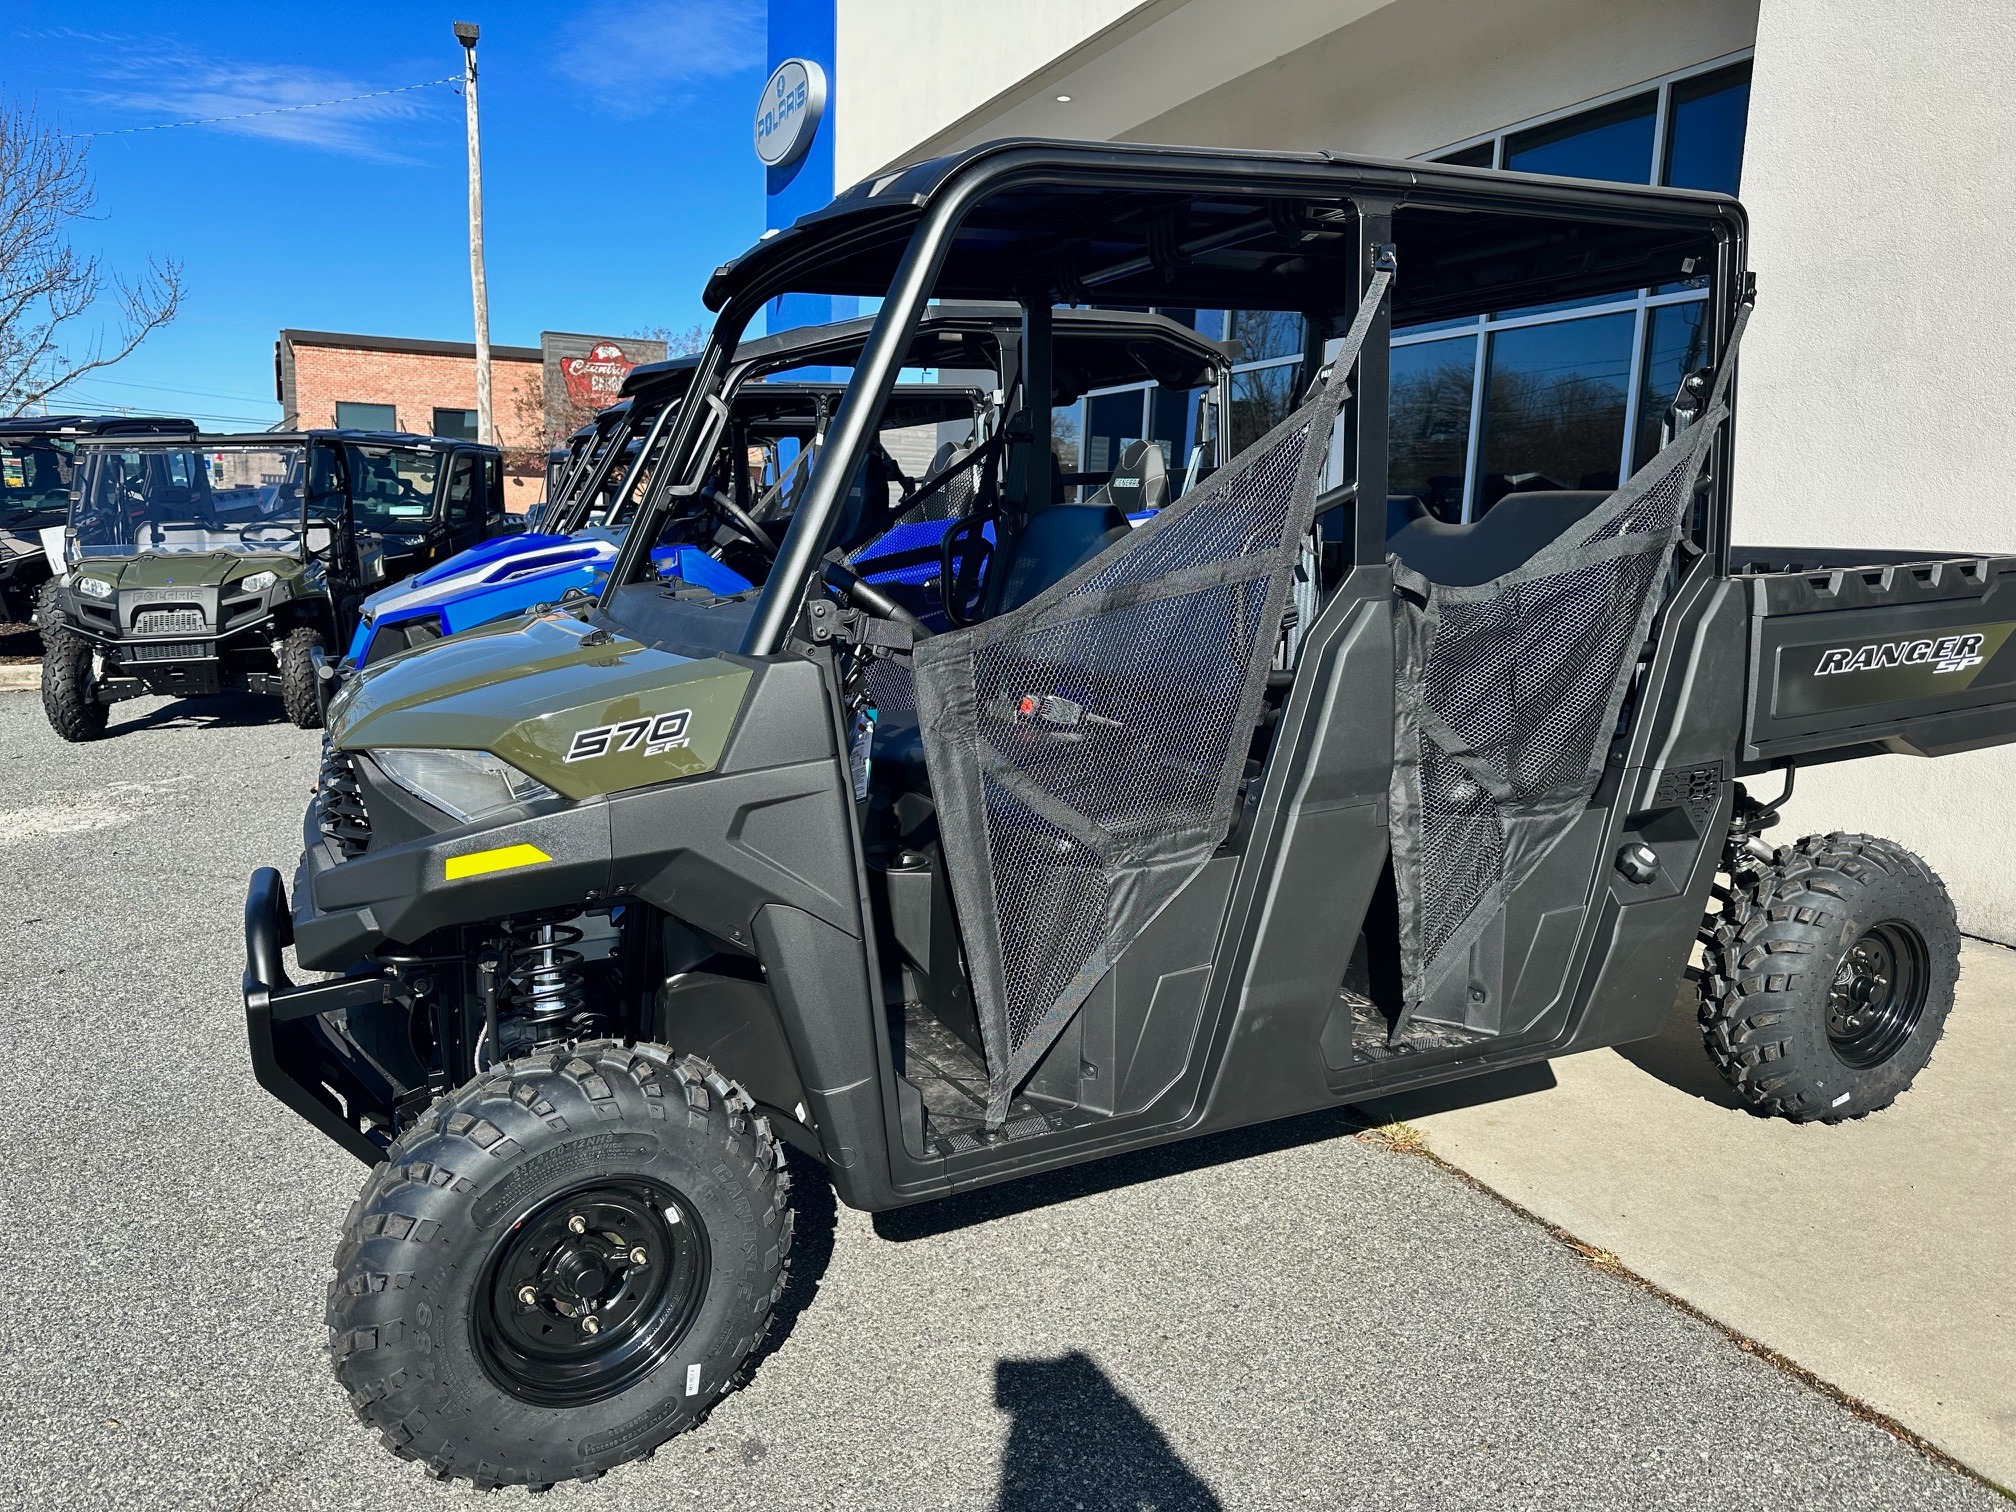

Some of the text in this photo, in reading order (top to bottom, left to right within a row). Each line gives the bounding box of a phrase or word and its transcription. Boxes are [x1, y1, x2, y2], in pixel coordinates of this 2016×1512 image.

[757, 80, 807, 144] POLARIS
[75, 516, 97, 528] XP
[132, 589, 204, 603] POLARIS
[1813, 633, 1985, 676] RANGER
[1932, 656, 1984, 674] SP
[562, 708, 693, 764] 570
[643, 737, 691, 758] EFI
[711, 1163, 758, 1302] CARLISLE
